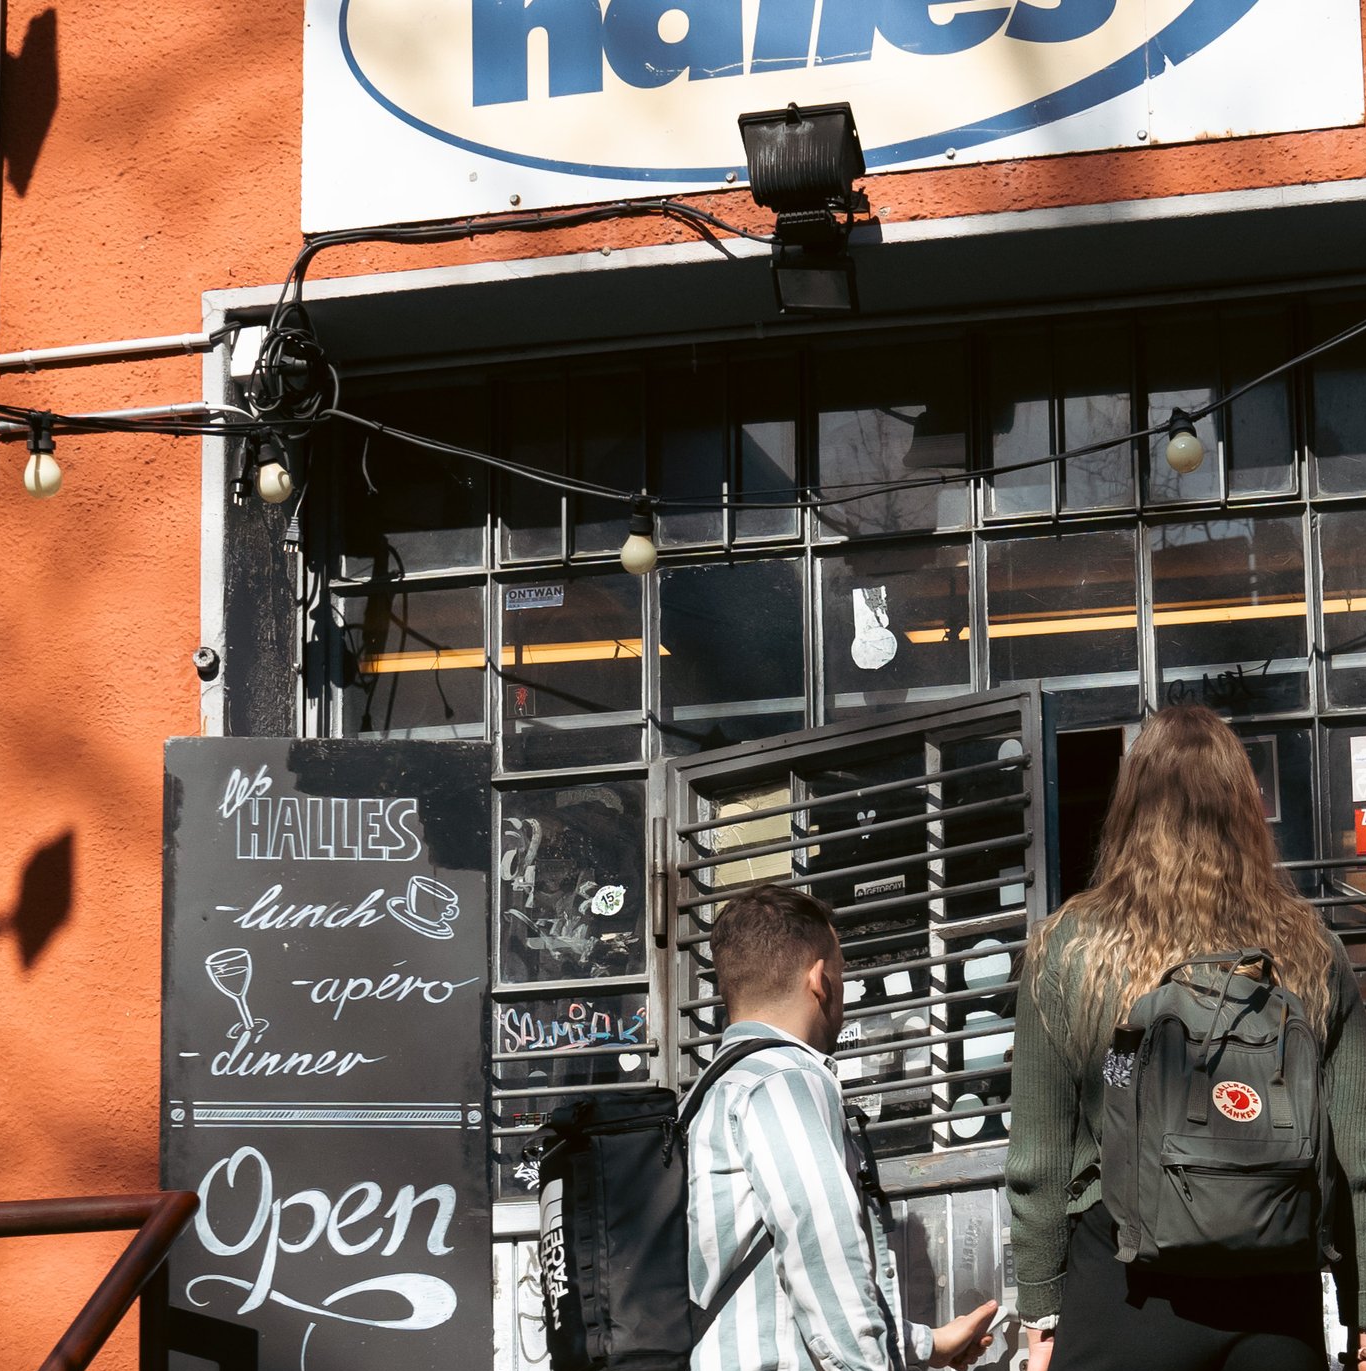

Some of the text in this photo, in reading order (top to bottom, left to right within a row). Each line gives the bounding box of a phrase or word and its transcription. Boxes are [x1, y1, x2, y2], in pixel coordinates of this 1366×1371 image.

[237, 797, 422, 862] HALLES
[194, 1145, 458, 1315] Open
[550, 1226, 570, 1301] FACE
